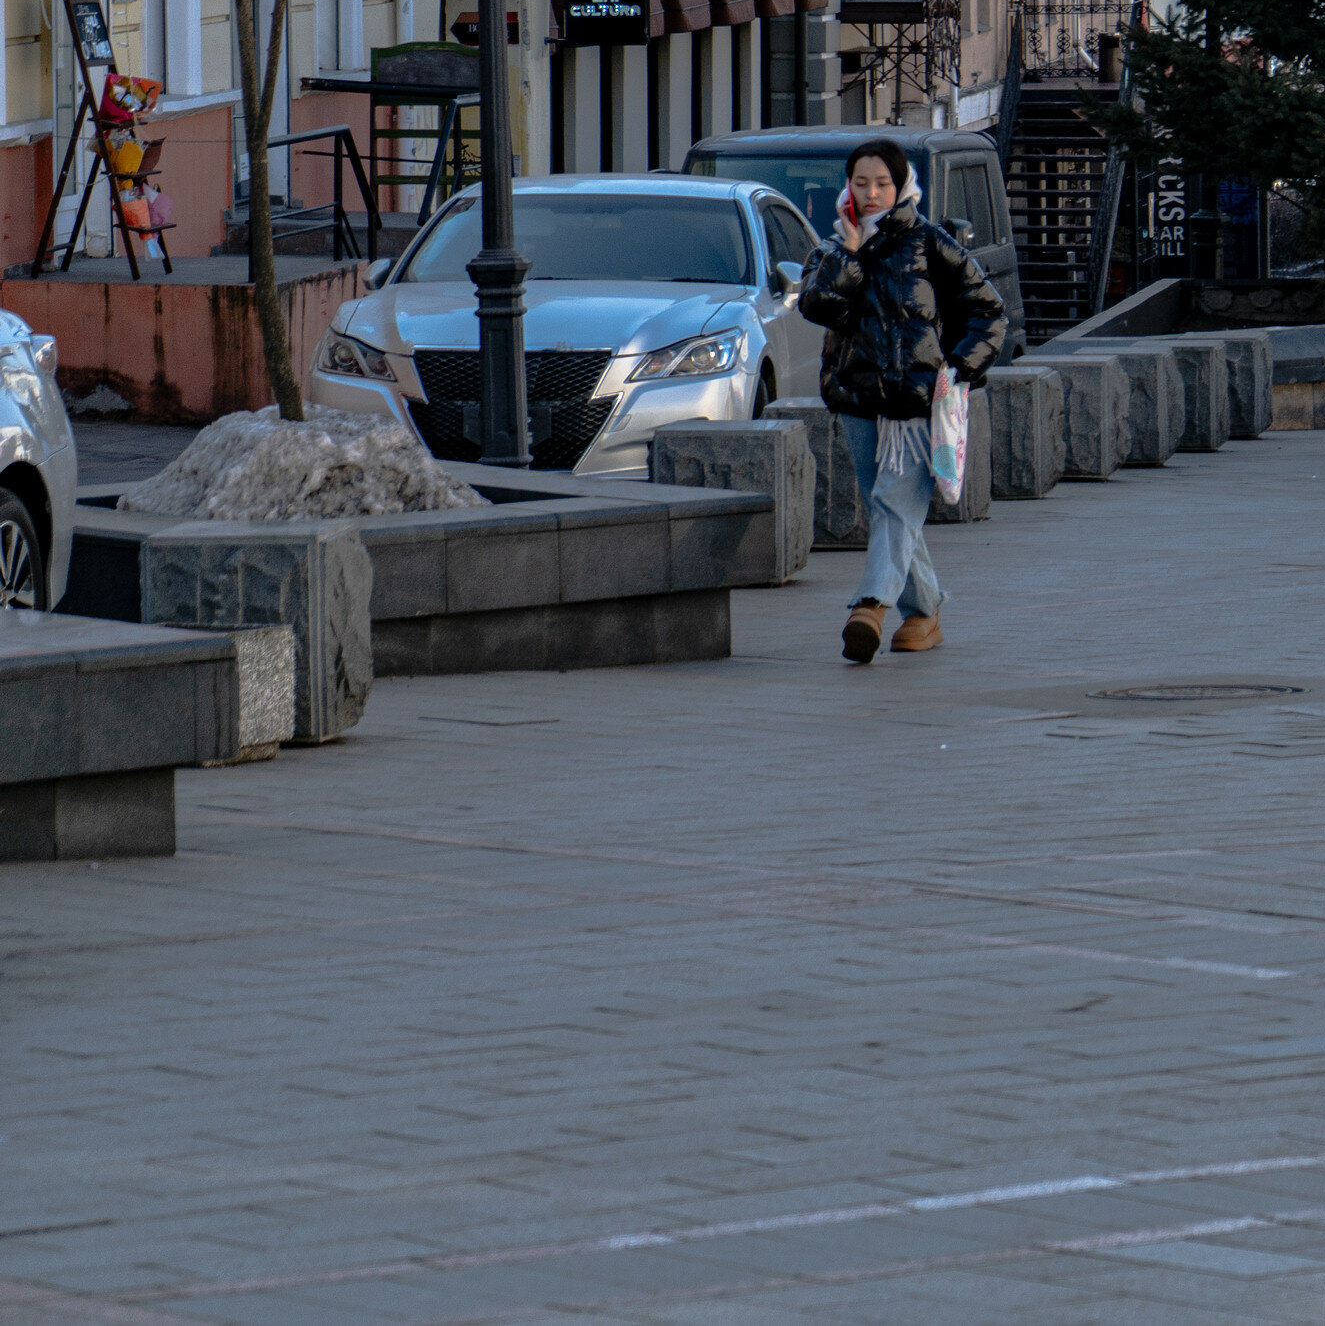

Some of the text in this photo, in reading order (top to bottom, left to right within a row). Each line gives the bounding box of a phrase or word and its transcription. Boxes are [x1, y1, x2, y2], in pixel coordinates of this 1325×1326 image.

[570, 4, 642, 17] CULTURA
[1158, 157, 1185, 221] CKS
[1160, 225, 1185, 241] AR
